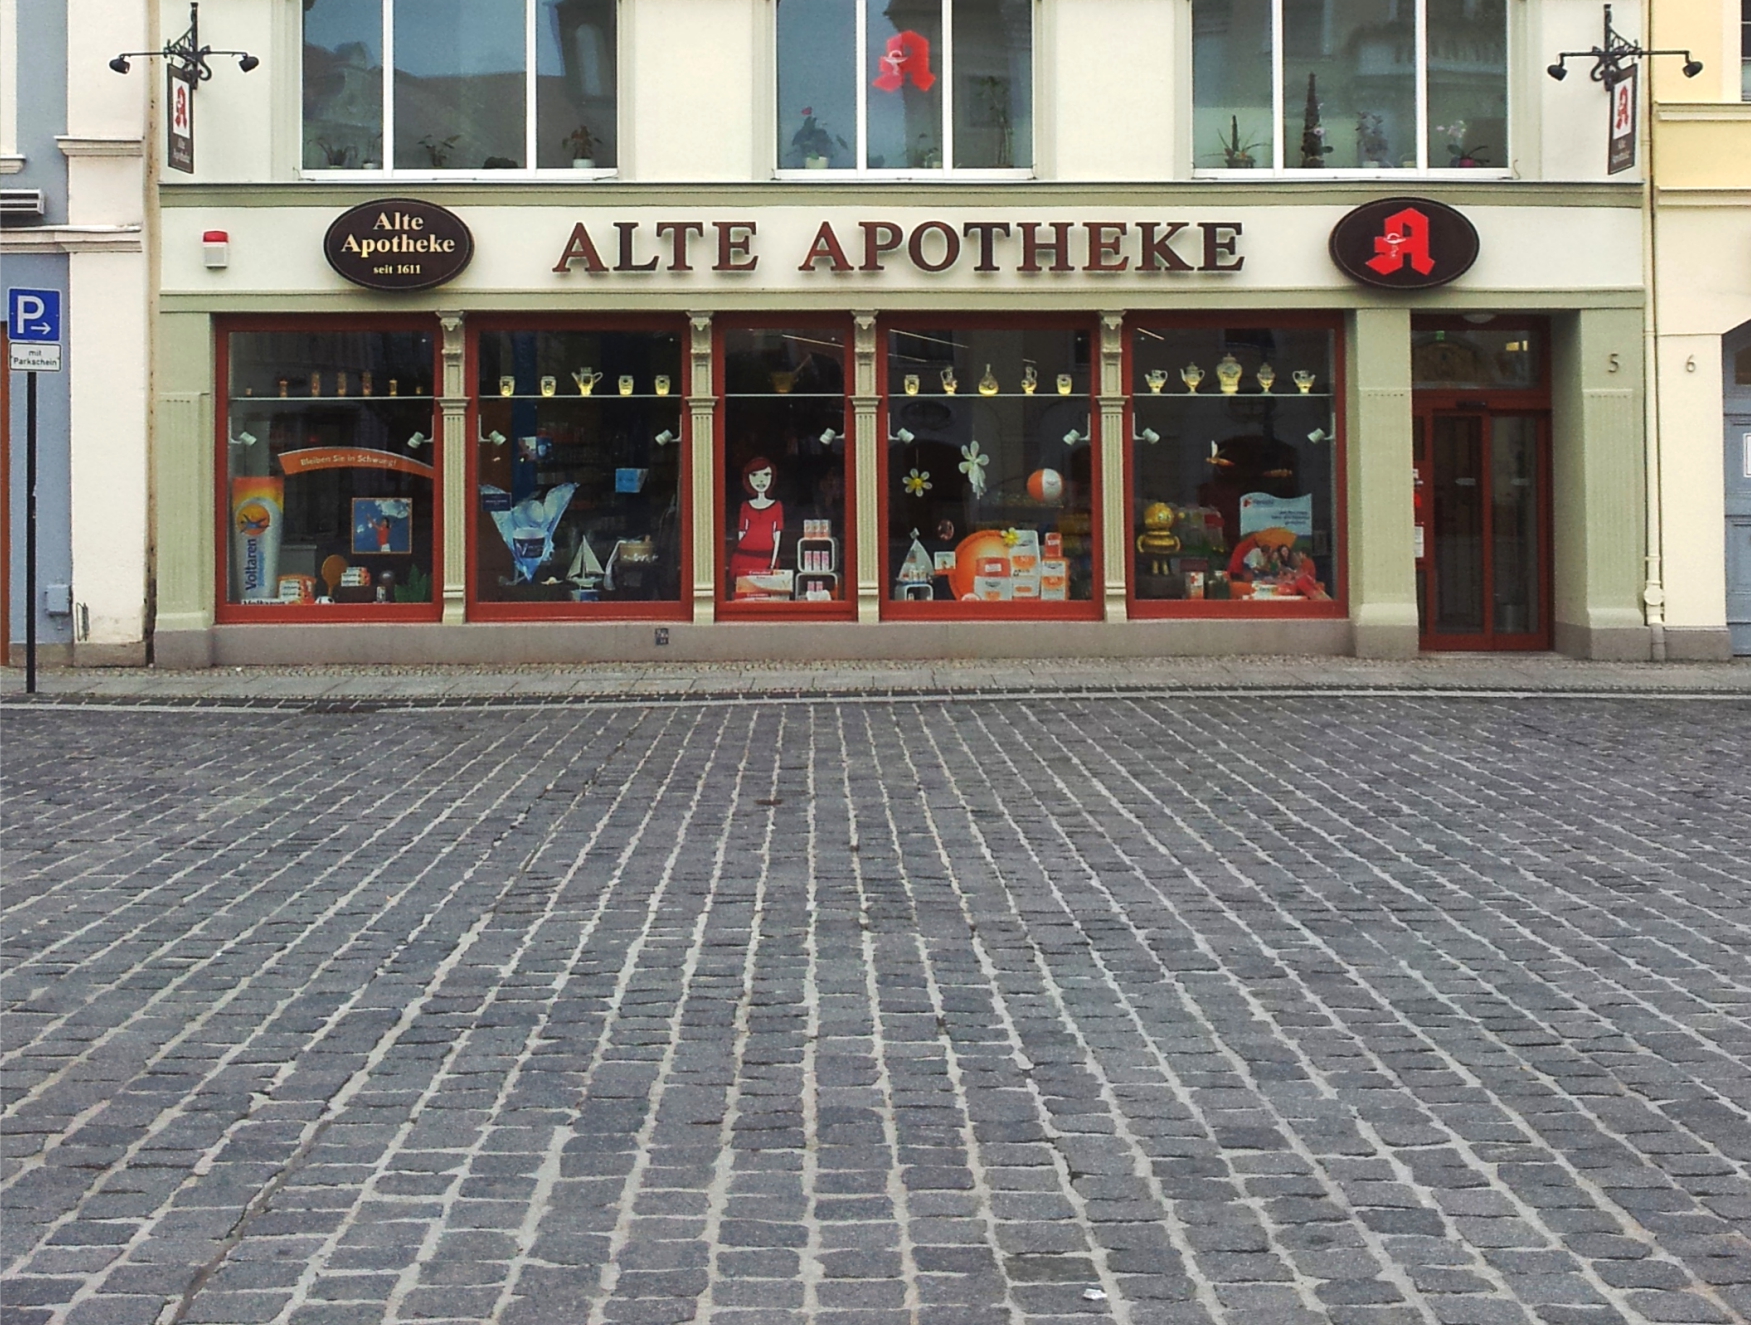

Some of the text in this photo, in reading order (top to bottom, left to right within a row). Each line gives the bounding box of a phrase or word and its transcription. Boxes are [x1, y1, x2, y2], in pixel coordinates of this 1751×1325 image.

[373, 212, 424, 230] Alte
[340, 234, 456, 258] Apotheke
[552, 221, 1245, 272] ALTE APOTHEKE
[373, 264, 421, 274] seit 1611
[17, 295, 45, 334] P
[13, 357, 57, 366] Parkschein
[1607, 353, 1620, 373] 5
[1685, 354, 1697, 373] 6
[300, 455, 331, 466] Bleiben
[245, 538, 257, 590] Voltaren
